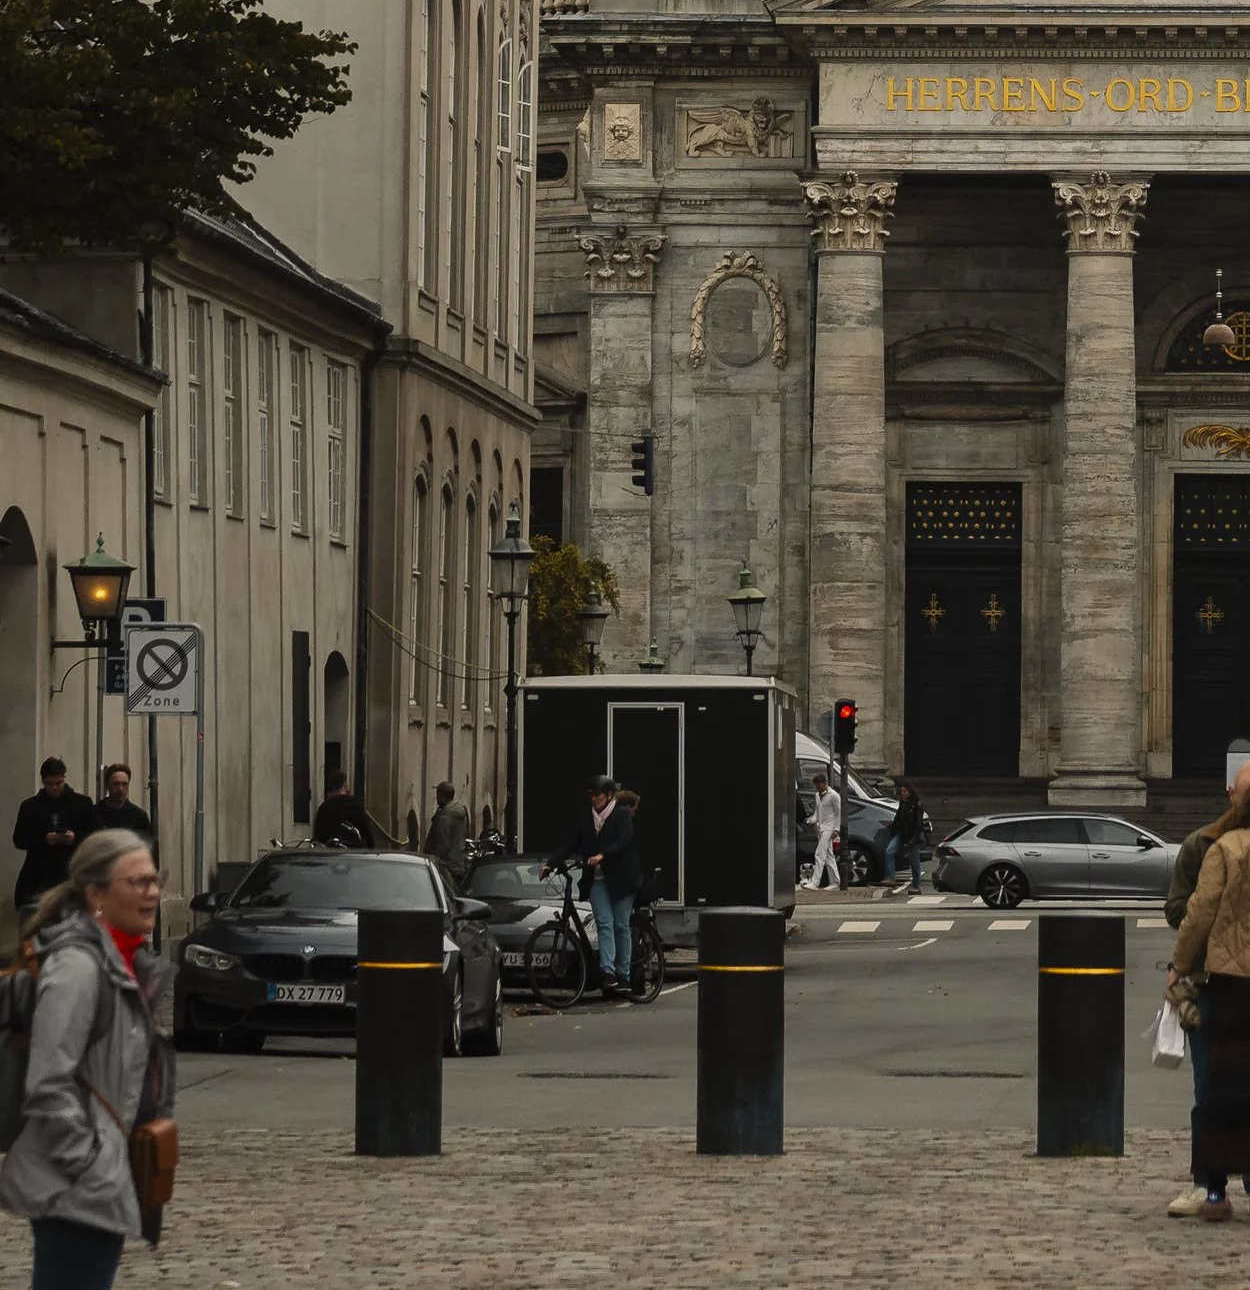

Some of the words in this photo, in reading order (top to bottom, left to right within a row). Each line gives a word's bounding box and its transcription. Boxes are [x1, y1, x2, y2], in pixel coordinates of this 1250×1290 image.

[886, 77, 1085, 112] HERRENS
[1105, 78, 1195, 113] ORD
[144, 695, 180, 707] Zone
[277, 987, 295, 1000] DX
[299, 987, 315, 1000] 27
[318, 987, 343, 1001] 779
